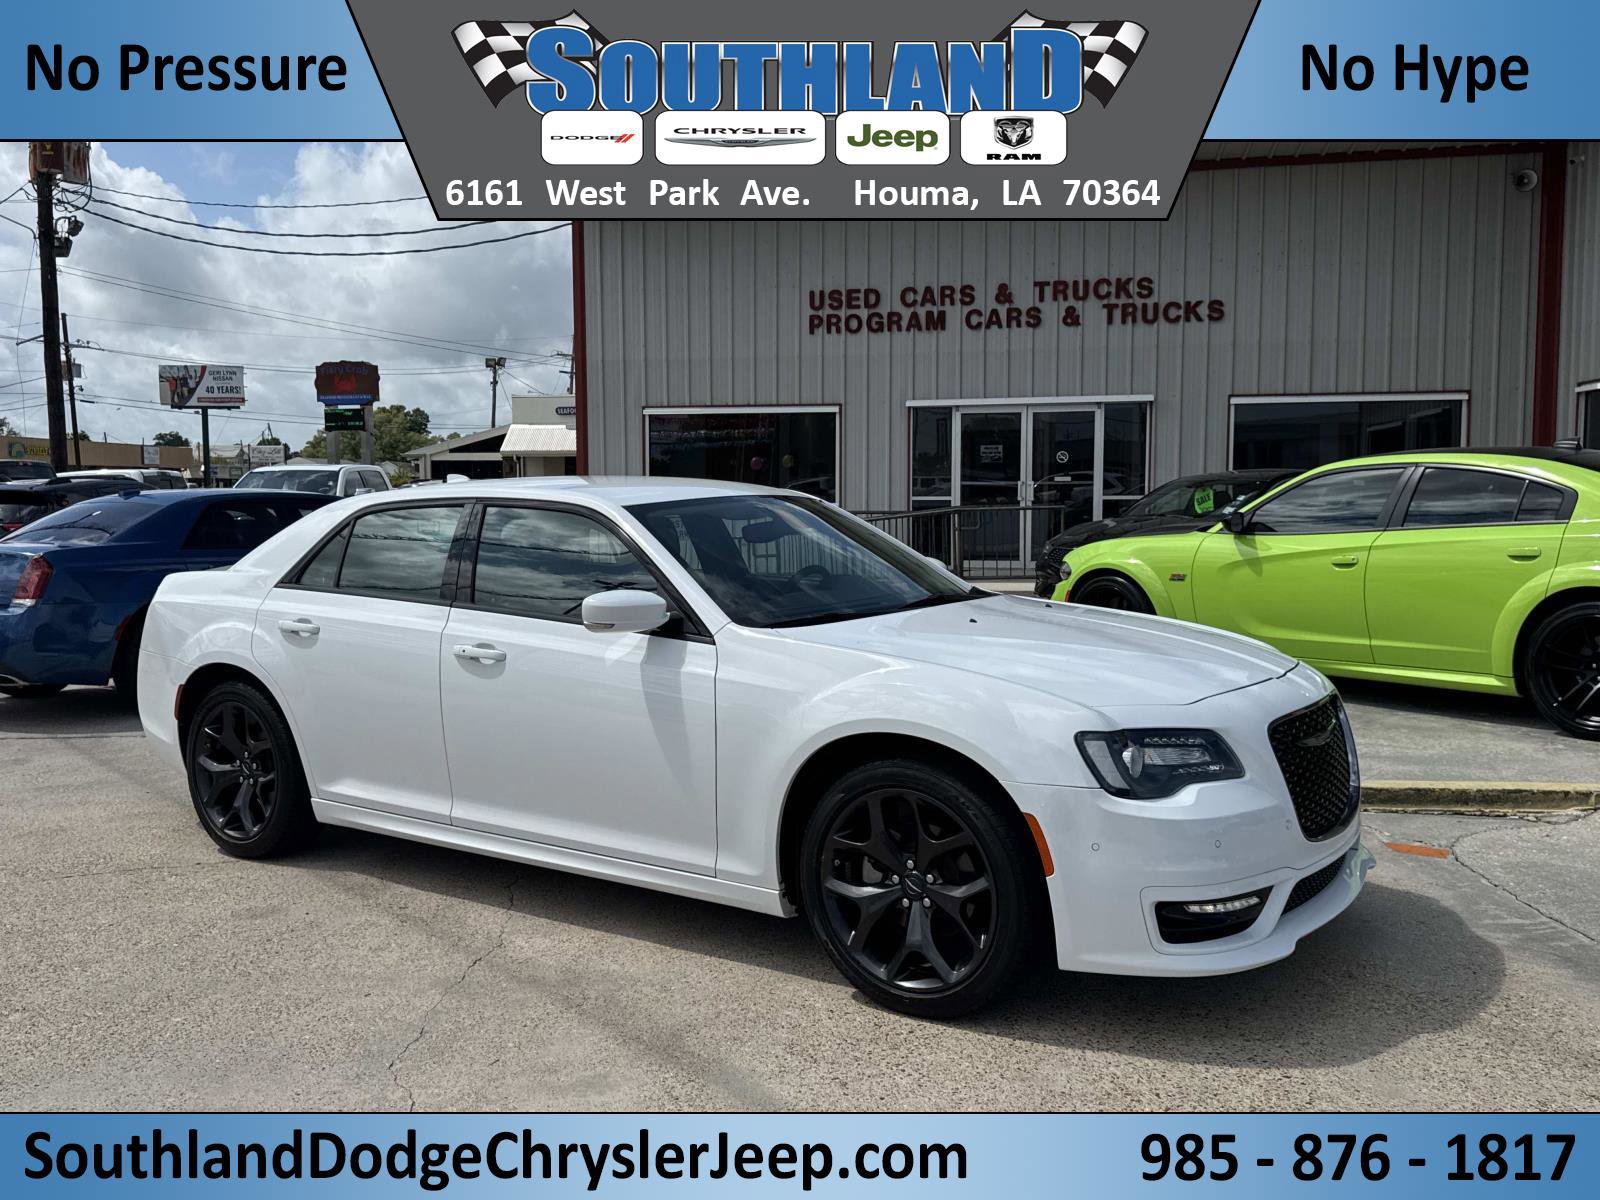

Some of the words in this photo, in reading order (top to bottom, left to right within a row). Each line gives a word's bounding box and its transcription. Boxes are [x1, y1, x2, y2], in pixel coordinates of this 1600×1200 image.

[808, 287, 881, 312] USED
[899, 283, 976, 309] CARS
[994, 282, 1014, 304] &
[1033, 276, 1155, 303] TRUCKS
[808, 309, 947, 336] PROGRAM
[964, 305, 1042, 331] CARS
[1061, 305, 1082, 328] &
[1101, 298, 1226, 327] TRUCKS
[205, 385, 215, 394] 40
[216, 385, 241, 394] YEARS!
